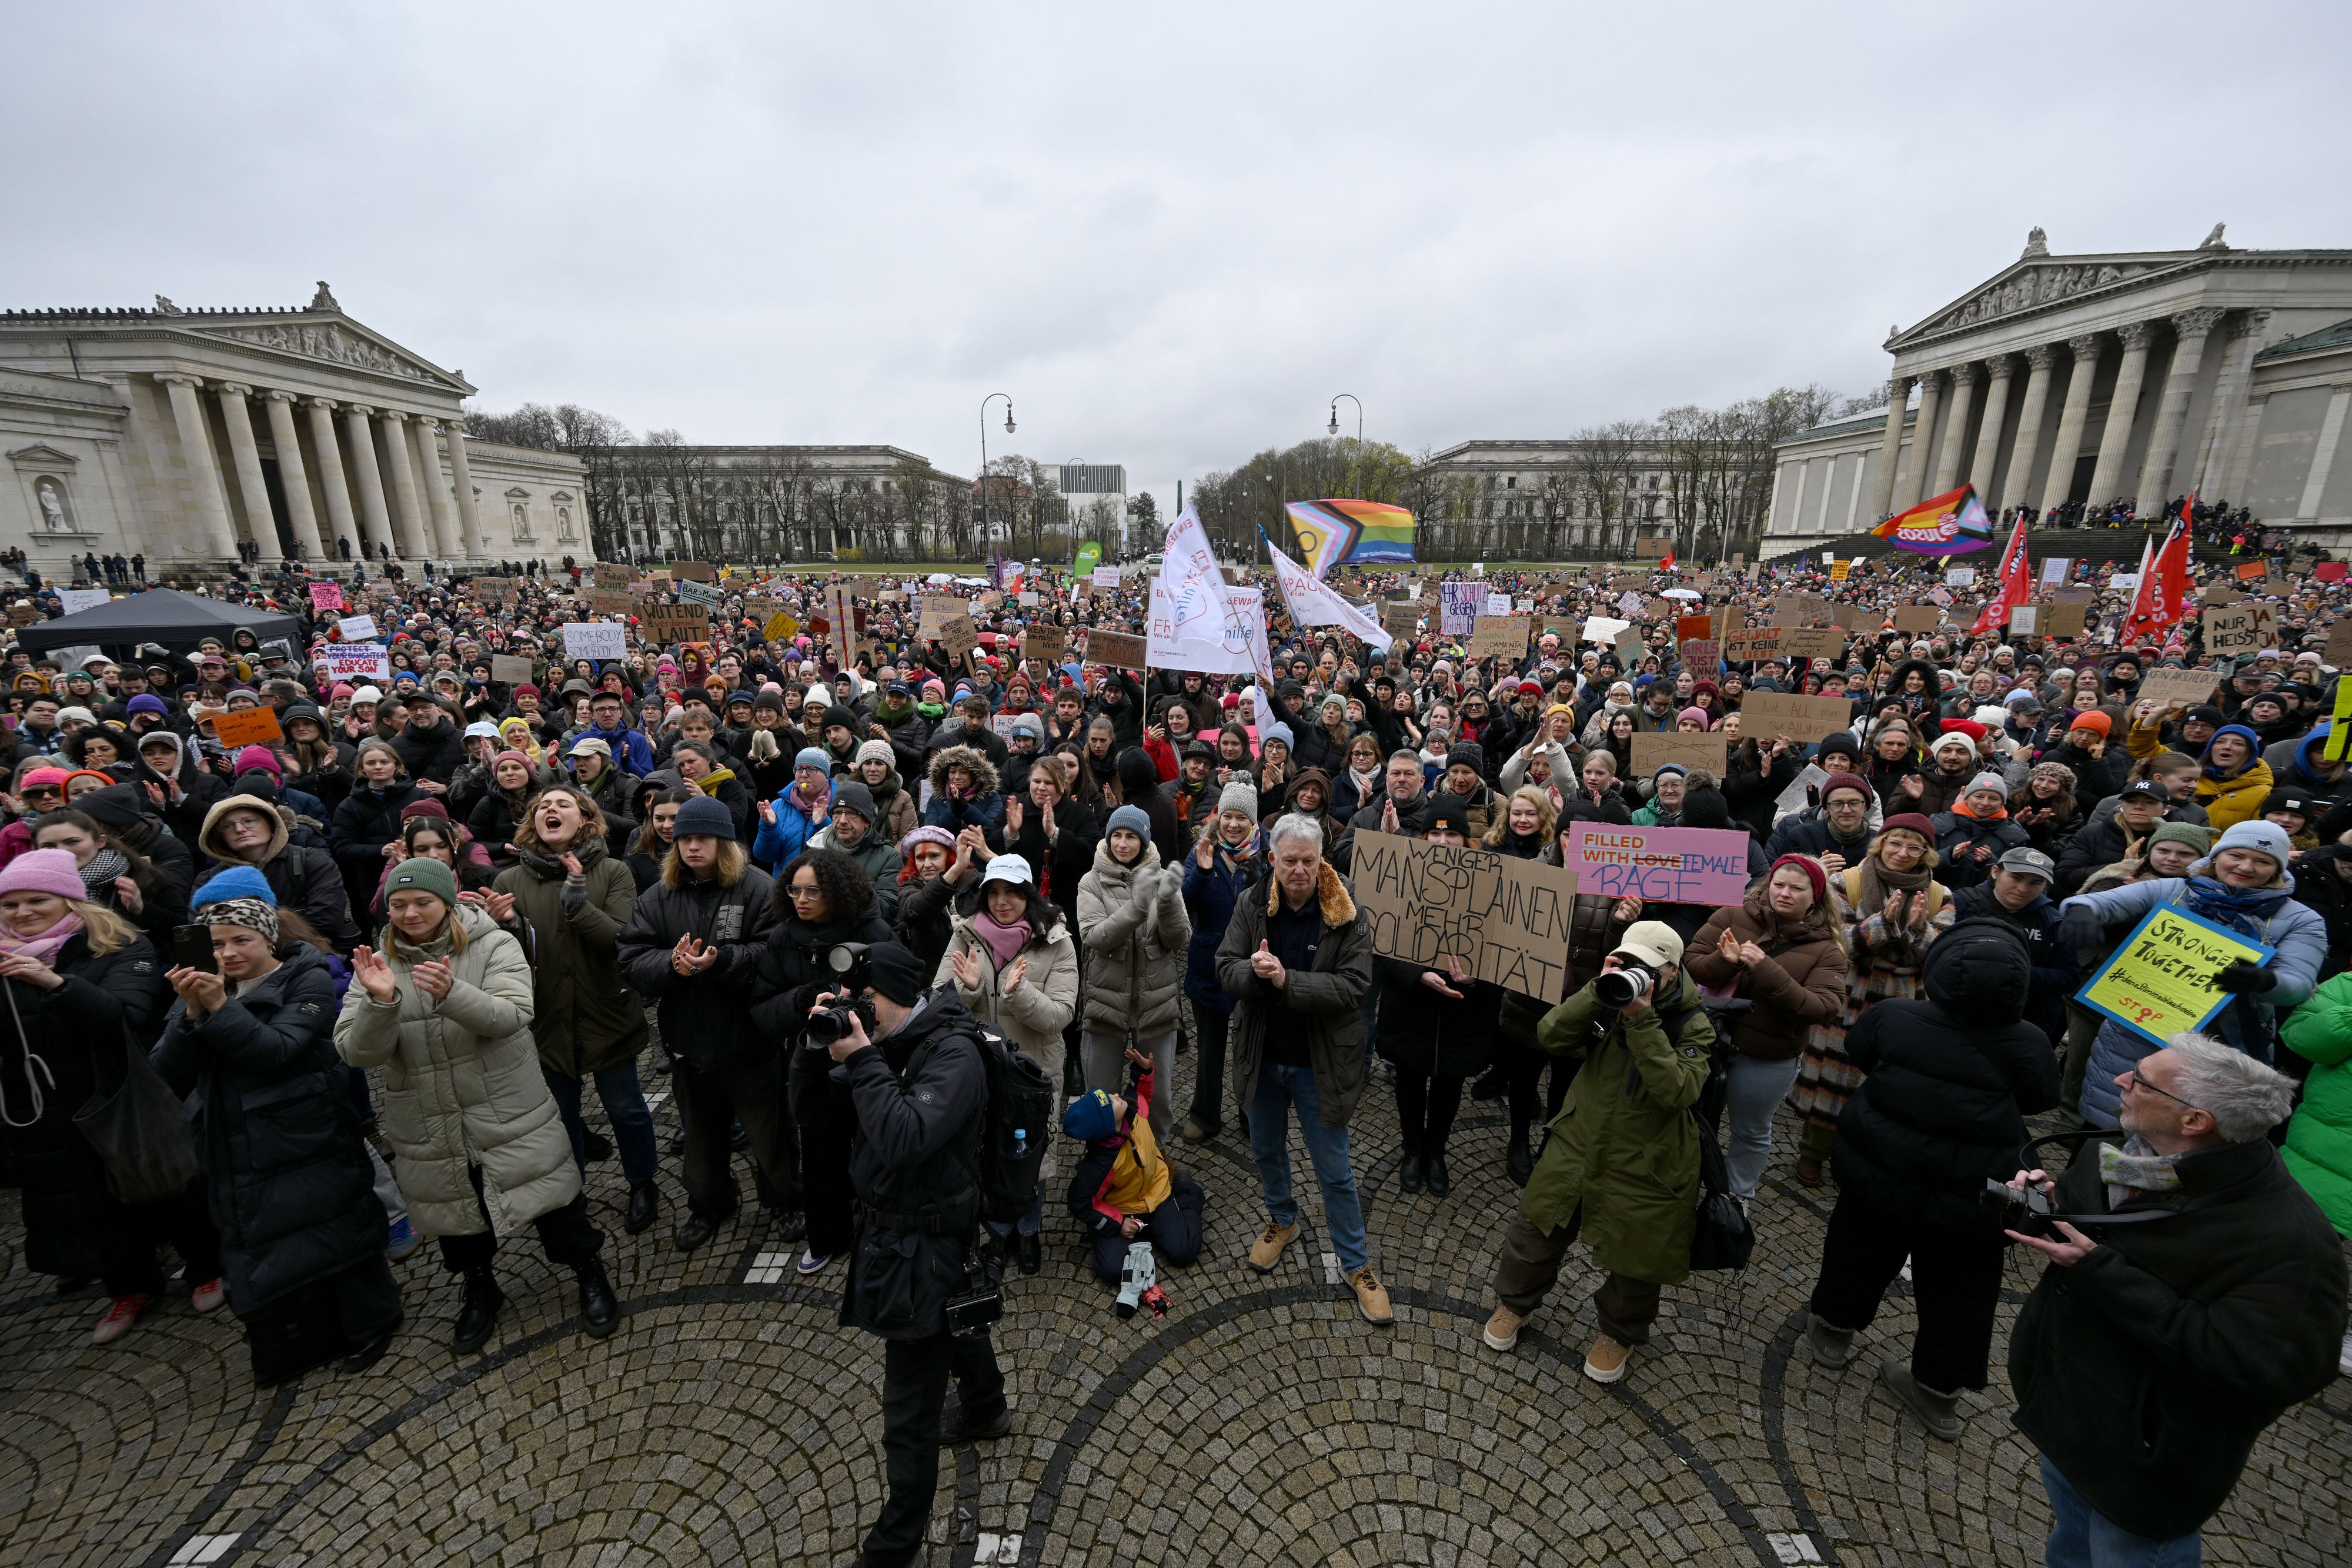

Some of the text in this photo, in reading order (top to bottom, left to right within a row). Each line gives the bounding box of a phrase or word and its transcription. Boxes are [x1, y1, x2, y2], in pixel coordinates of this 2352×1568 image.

[603, 573, 629, 581] FORDERN
[482, 580, 513, 591] enough
[597, 581, 627, 593] SCHUTZ
[479, 592, 507, 603] enough
[1441, 583, 1487, 603] MEHR SCHUTZ
[932, 599, 955, 611] Einfach
[1450, 603, 1476, 615] GEGEN
[654, 618, 696, 627] verdammt
[936, 614, 951, 623] Kein
[2214, 609, 2271, 633] NUR JA
[345, 624, 373, 634] Opferschutz
[1028, 626, 1060, 636] KEIN Täter
[1154, 618, 1171, 633] FR
[1441, 616, 1467, 634] DIGITALE
[1482, 619, 1529, 631] GIRLS JUST
[567, 629, 623, 643] SOMEBODY,
[954, 630, 970, 640] SEITE
[955, 634, 978, 647] WECHSELN
[1728, 627, 1782, 642] GEWALT
[2213, 630, 2277, 648] HEISST JA
[1103, 637, 1142, 647] misstrauen
[1475, 641, 1526, 649] FUNDAMENTAL
[1728, 640, 1779, 651] IST KEINE
[1484, 648, 1524, 657] RIGHTS
[1682, 642, 1719, 655] GIRLS
[1742, 650, 1775, 659] LIEBE
[1685, 656, 1716, 666] JUST
[331, 666, 356, 674] YOUR
[2147, 671, 2219, 684] KEIN ARSCHLOCH
[1762, 701, 1840, 718] Not ALL men
[1768, 720, 1785, 731] But
[1638, 737, 1663, 750] Protect
[1698, 750, 1725, 775] SON!
[2136, 781, 2150, 790] NY
[1585, 834, 1644, 848] FILLED
[1409, 840, 1502, 876] WENIGER
[1583, 850, 1682, 868] WITH LOVE
[1680, 854, 1744, 875] FEMALE
[1591, 864, 1704, 902] RAGE
[1352, 845, 1573, 943] MANSPLAINEN
[1406, 900, 1484, 940] MEHR
[1357, 925, 1369, 934] HR
[2134, 941, 2217, 994] TOGETHER
